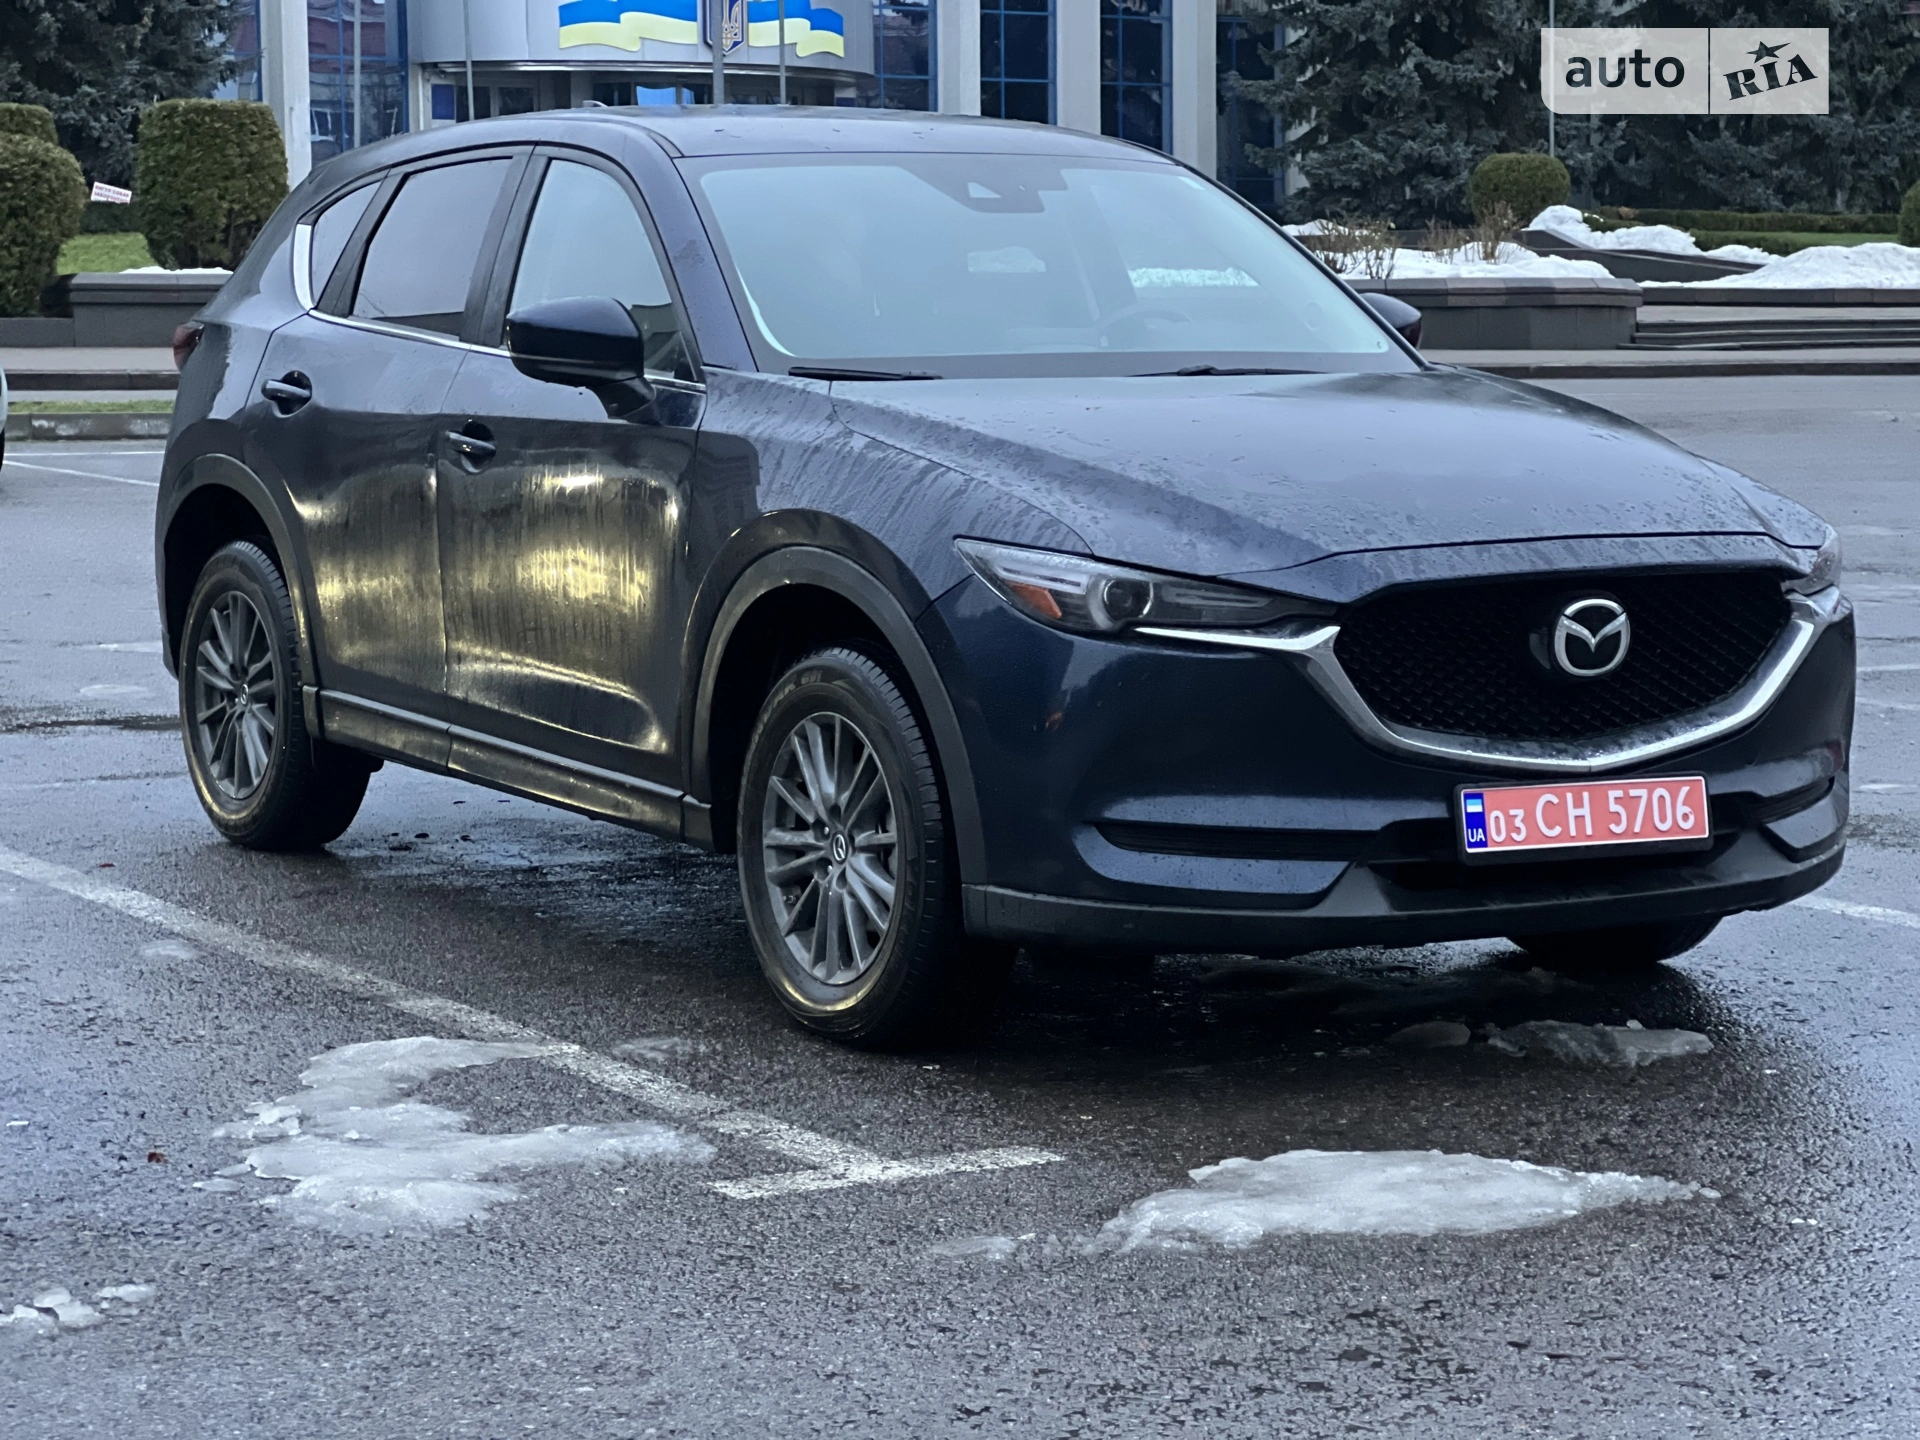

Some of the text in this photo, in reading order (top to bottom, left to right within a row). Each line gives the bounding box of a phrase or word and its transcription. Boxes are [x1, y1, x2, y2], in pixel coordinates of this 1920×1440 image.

[1468, 786, 1695, 843] UA 03 CH 5706
